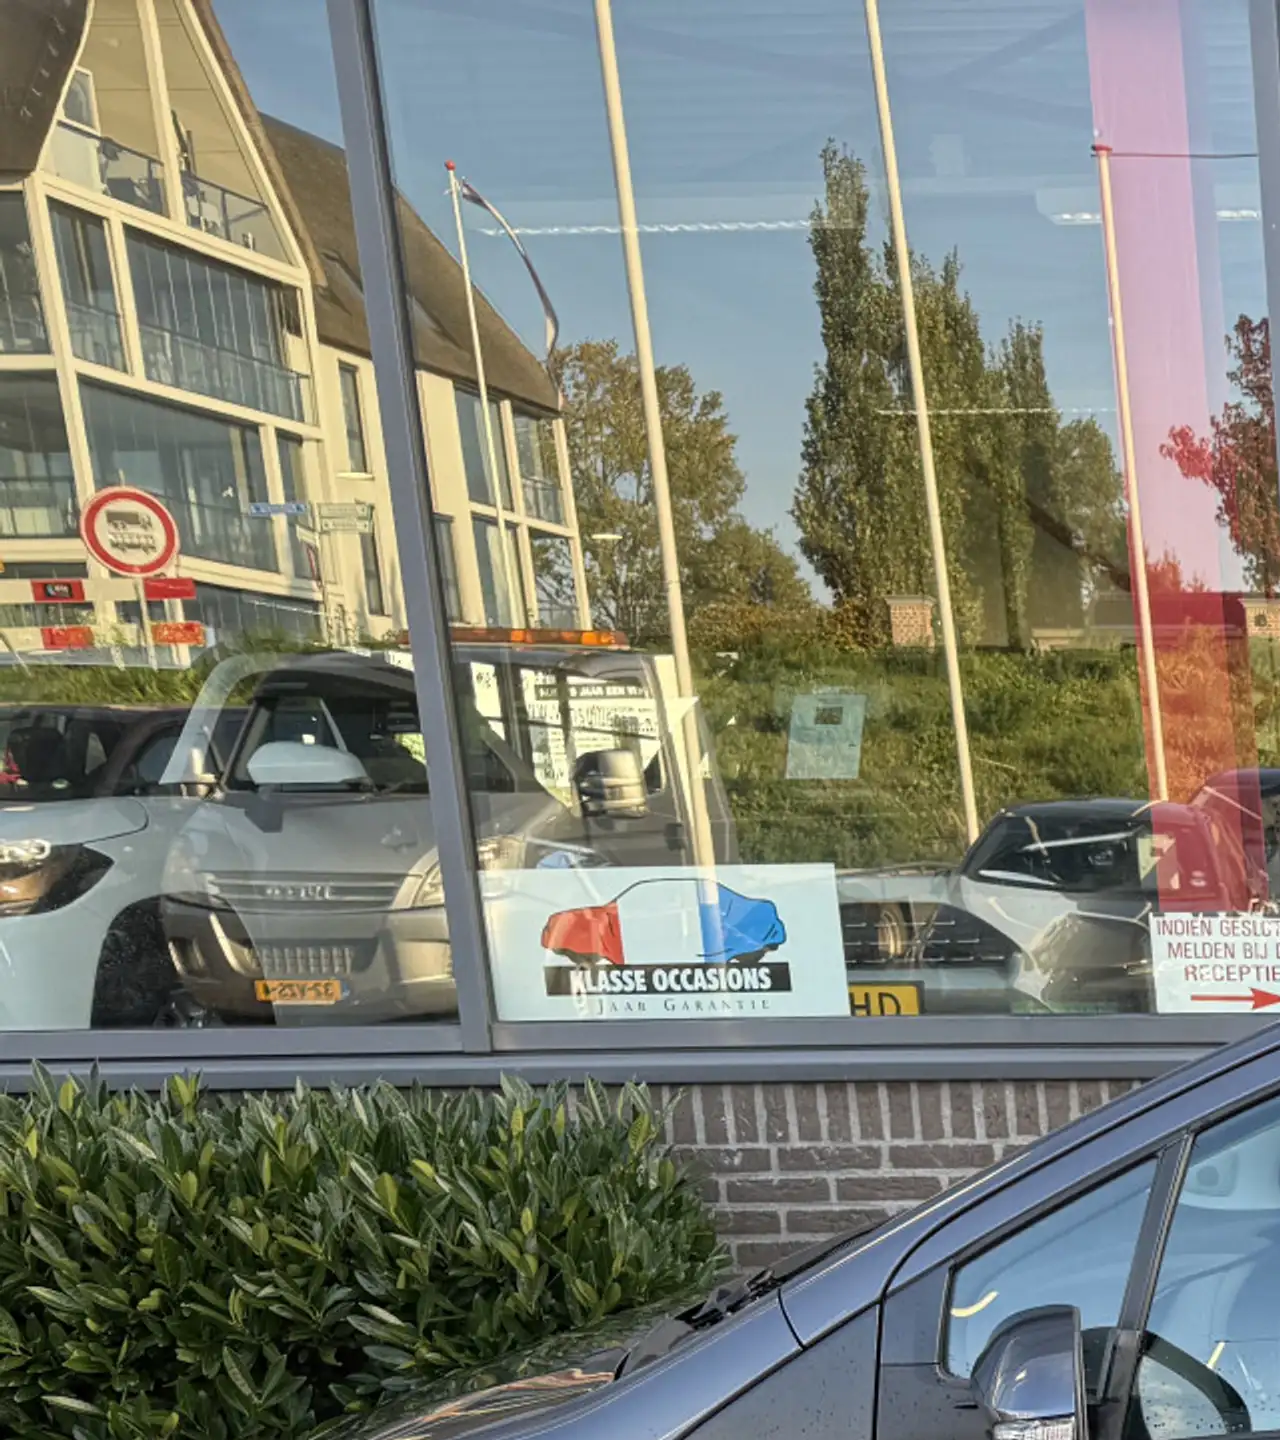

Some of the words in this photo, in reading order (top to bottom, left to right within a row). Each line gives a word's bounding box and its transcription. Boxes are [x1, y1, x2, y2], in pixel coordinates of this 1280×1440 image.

[1156, 919, 1212, 937] INDIEN
[1167, 942, 1236, 959] MELDEN
[1243, 942, 1268, 959] BIJ
[569, 968, 647, 993] KLASSE
[652, 967, 772, 992] OCCASIONS
